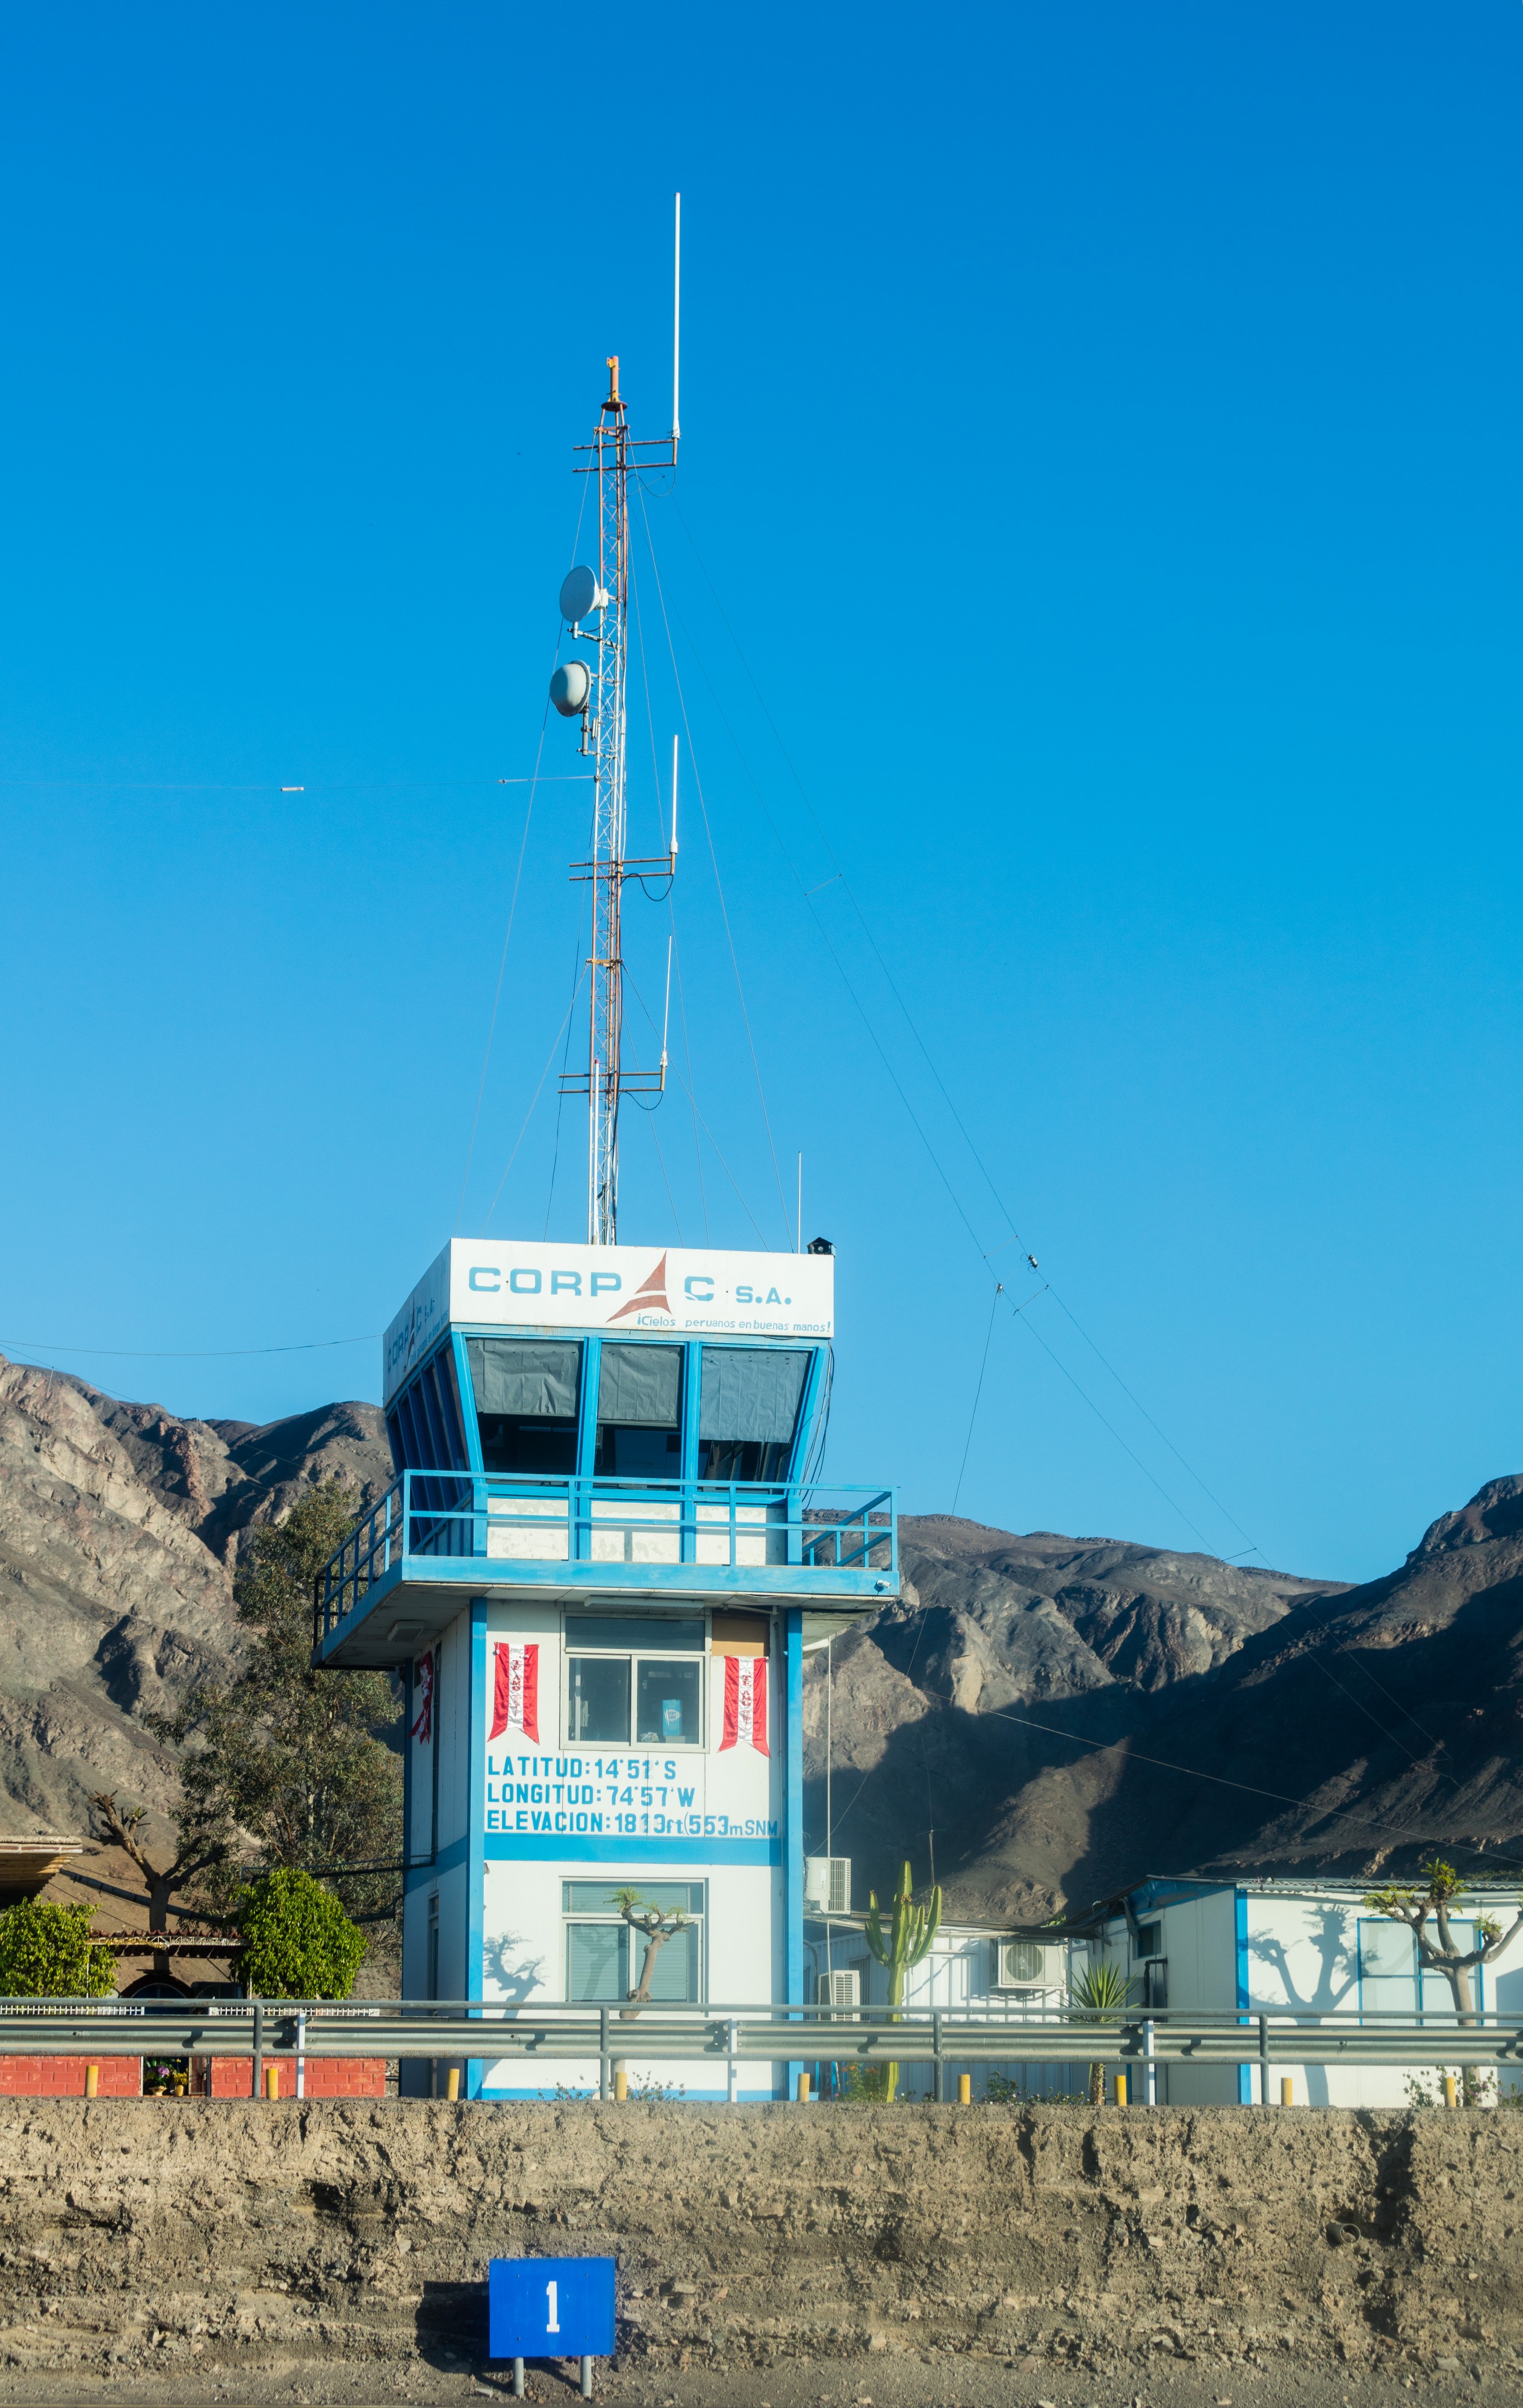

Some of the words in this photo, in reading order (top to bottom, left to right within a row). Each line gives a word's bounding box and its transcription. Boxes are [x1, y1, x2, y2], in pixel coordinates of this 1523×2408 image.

[736, 1285, 792, 1305] S.A.
[637, 1313, 675, 1326] ¡Cielos
[685, 1318, 736, 1328] peruanos
[739, 1320, 751, 1329] en
[753, 1320, 789, 1330] buenas
[793, 1321, 831, 1332] manos!
[546, 2281, 560, 2333] 1
